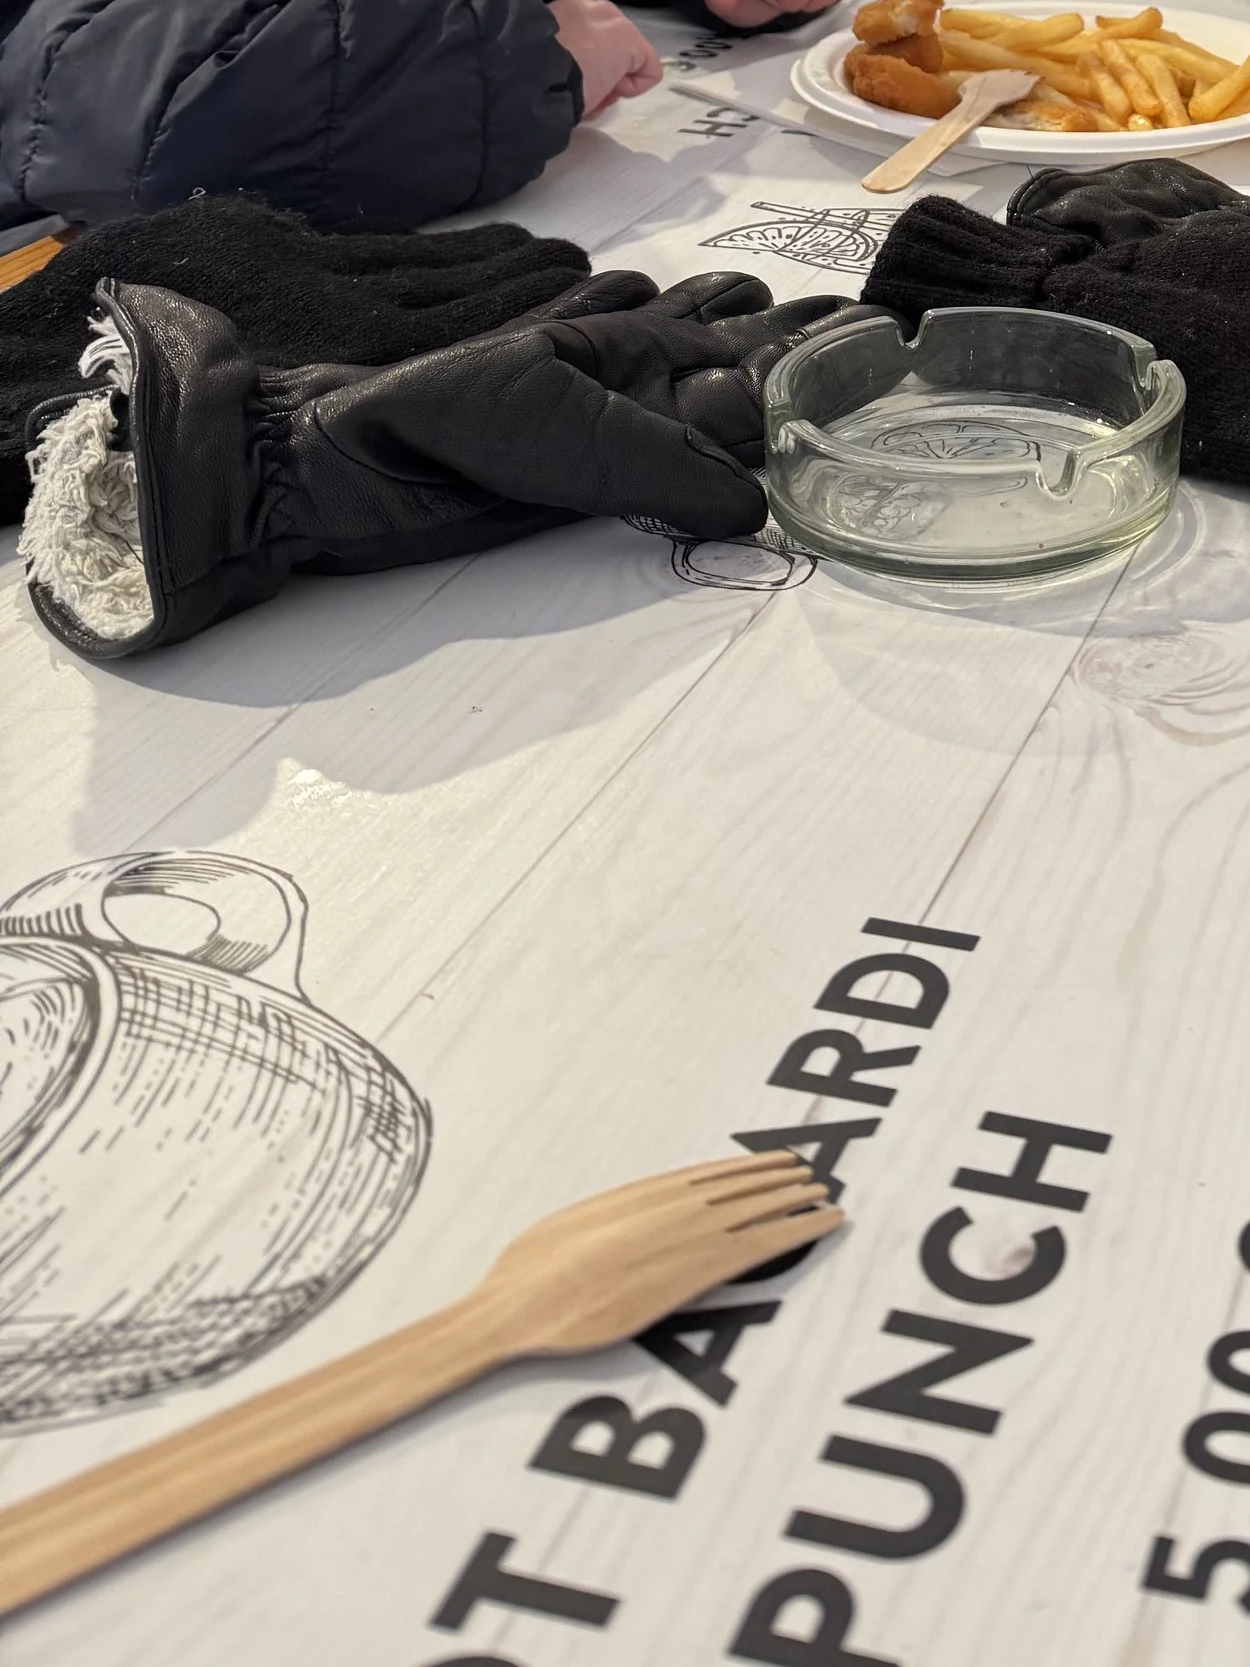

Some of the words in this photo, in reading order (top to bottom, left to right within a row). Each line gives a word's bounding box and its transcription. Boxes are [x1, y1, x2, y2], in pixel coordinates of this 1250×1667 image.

[414, 1530, 622, 1667] T
[527, 917, 981, 1503] BAARDI
[725, 1111, 1112, 1667] PUNCH
